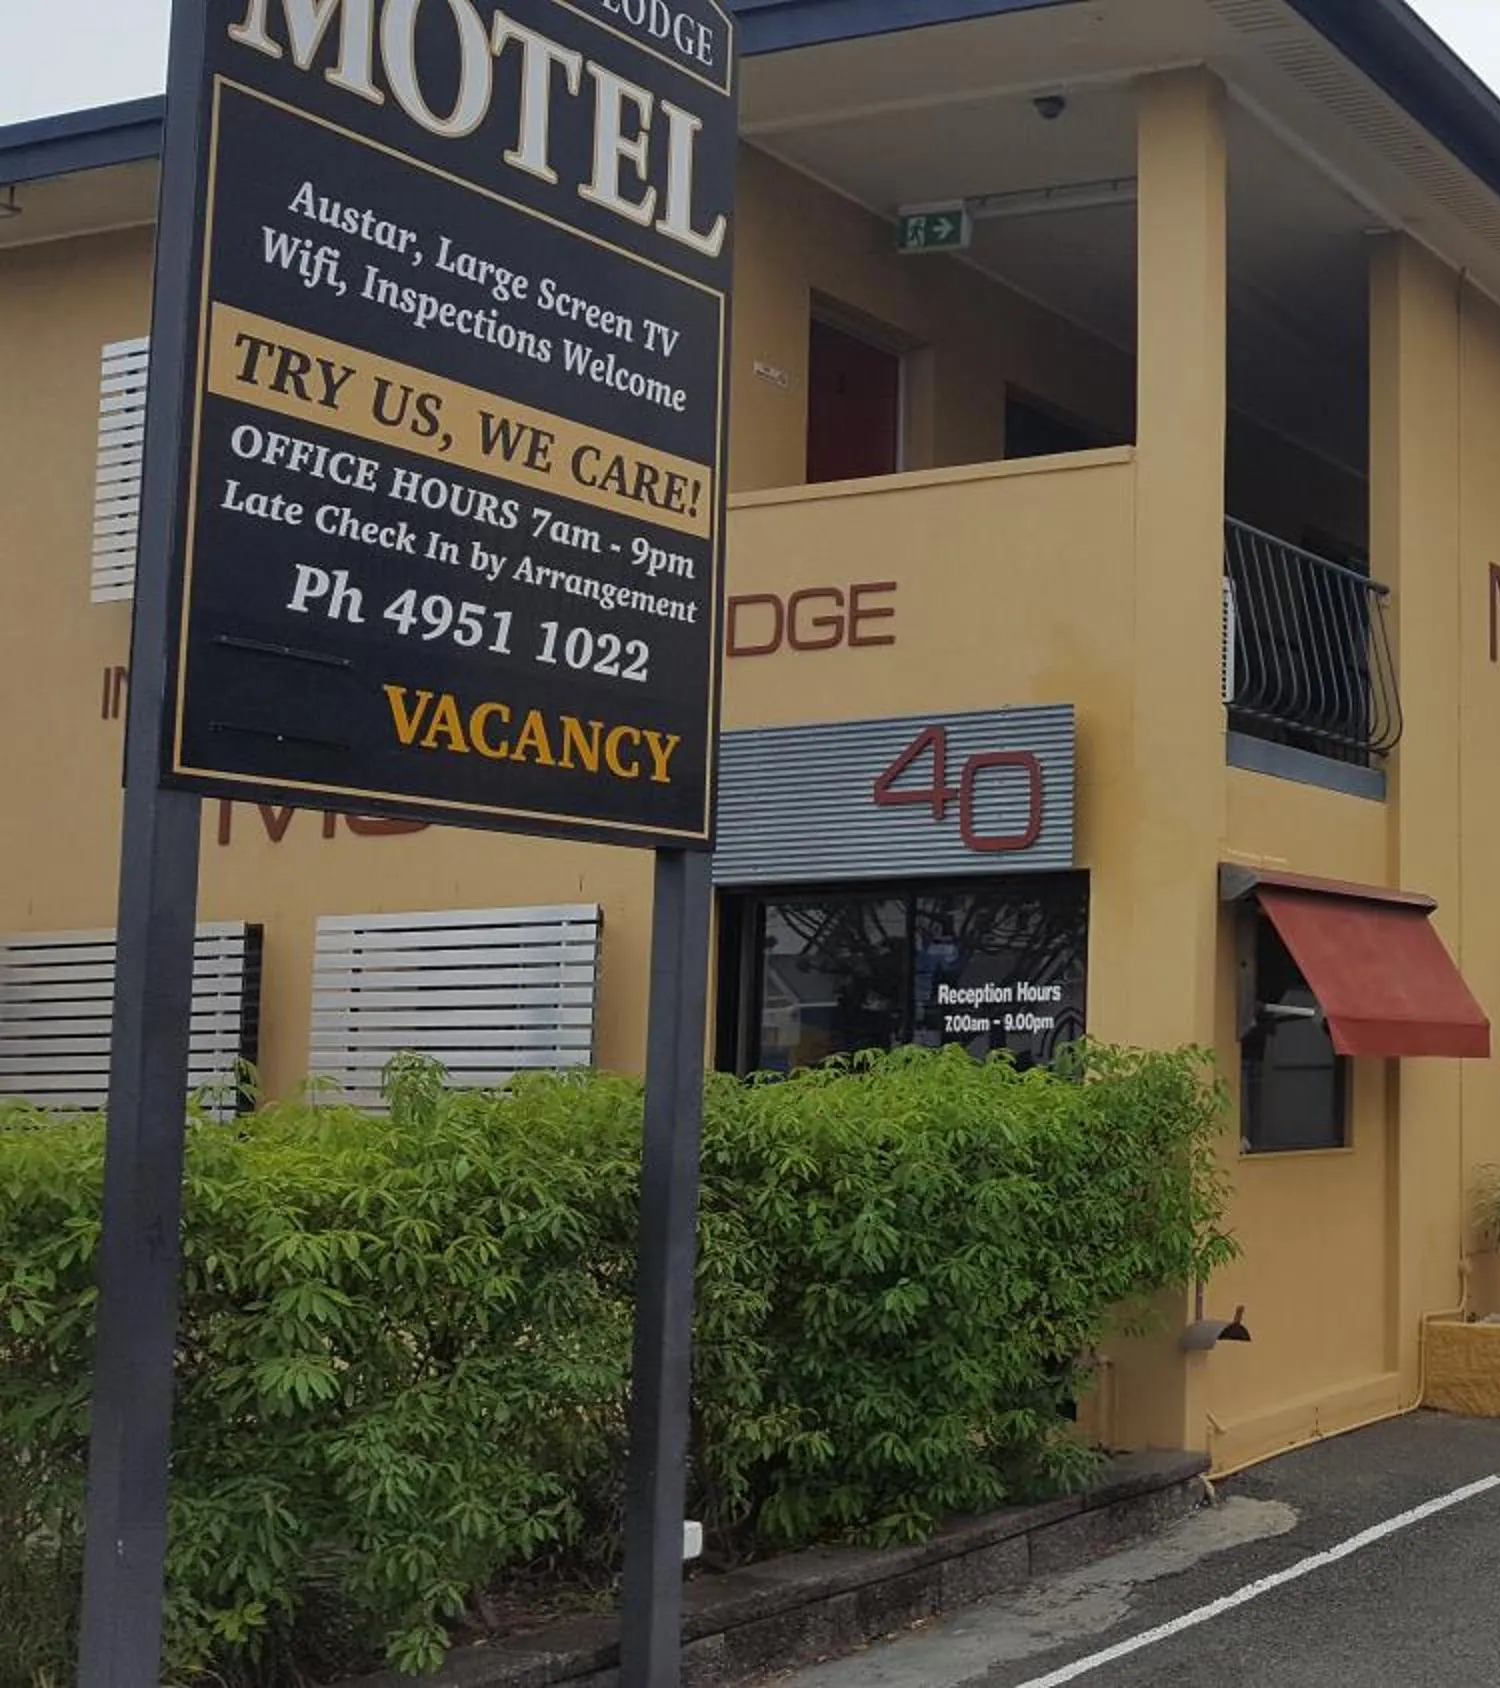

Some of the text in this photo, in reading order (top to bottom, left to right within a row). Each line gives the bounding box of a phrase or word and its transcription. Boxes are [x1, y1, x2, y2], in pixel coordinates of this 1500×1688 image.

[261, 226, 687, 412] Wifi, Inspections Welcome
[288, 181, 680, 358] Austar, Large Screen TV
[234, 333, 702, 517] TRY US, WE CARE!
[220, 479, 698, 624] Late Check In by Arrangement
[230, 424, 379, 493] OFFICE
[388, 467, 519, 530] HOURS
[531, 508, 601, 554] 7am
[631, 537, 695, 580] 9pm
[286, 563, 650, 683] Ph 4951 1022
[726, 582, 897, 658] DGE
[383, 683, 682, 784] VACANCY
[873, 725, 1044, 852] 40
[937, 981, 1061, 1008] Reception Hours
[1004, 1013, 1055, 1034] 9.00pm
